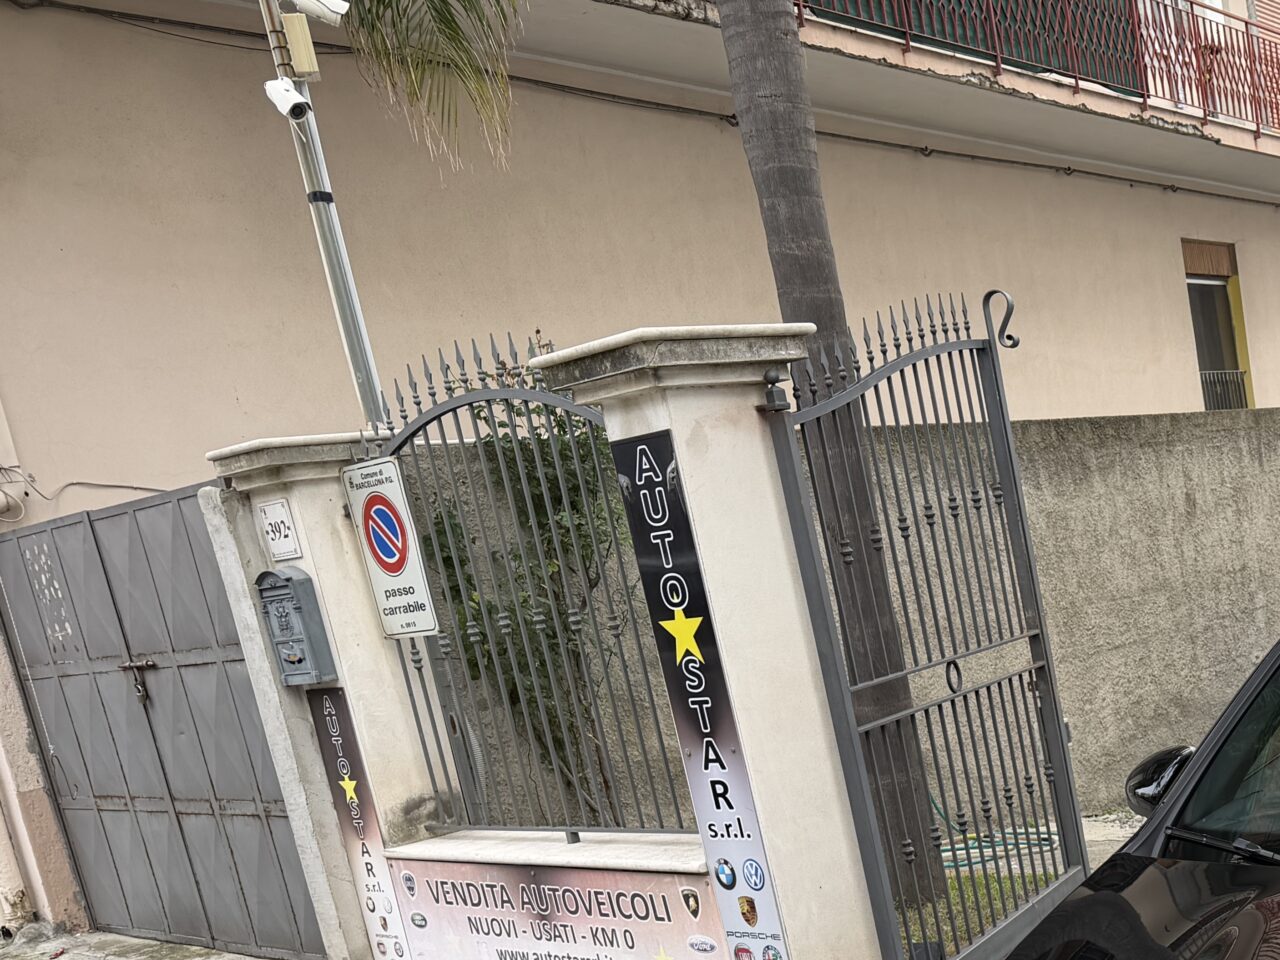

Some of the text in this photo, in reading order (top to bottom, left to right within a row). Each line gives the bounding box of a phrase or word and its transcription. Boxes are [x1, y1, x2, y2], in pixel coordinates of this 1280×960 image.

[361, 471, 378, 480] Comune
[355, 477, 385, 491] BARCELLONA
[384, 586, 415, 601] passo
[383, 601, 427, 617] carrabile
[635, 445, 735, 812] AUTO STAR
[323, 695, 376, 878] AUTO STAR
[707, 818, 752, 839] s.r.l.
[365, 881, 385, 893] s.r.l.
[426, 879, 672, 922] VENDITA AUTOVEICOLI
[467, 916, 518, 939] NUOVI
[531, 921, 577, 944] USATI
[590, 926, 620, 949] KM
[623, 929, 635, 949] 0
[726, 931, 782, 941] PORSCHE
